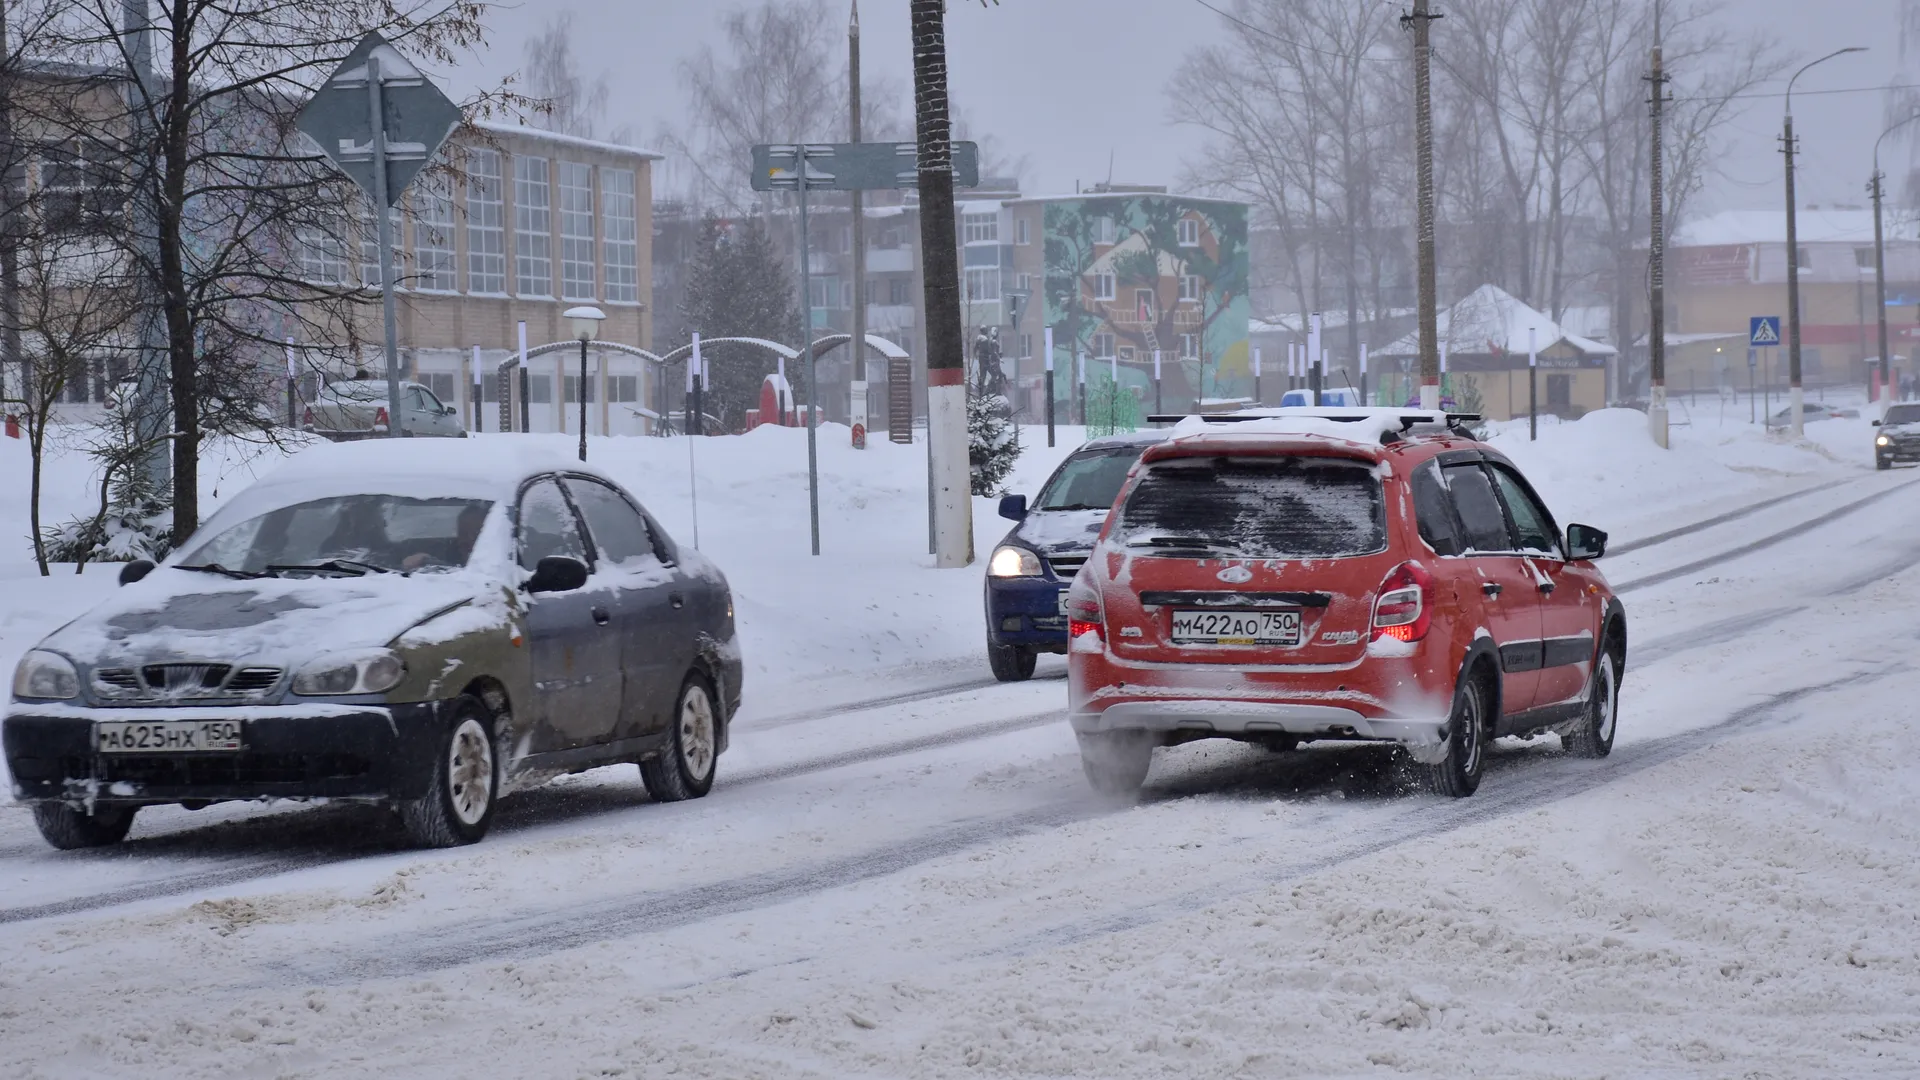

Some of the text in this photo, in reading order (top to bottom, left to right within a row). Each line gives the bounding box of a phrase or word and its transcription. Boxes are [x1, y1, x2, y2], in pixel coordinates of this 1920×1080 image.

[1178, 613, 1293, 635] М422АО 750
[107, 723, 235, 749] А625НХ 150
